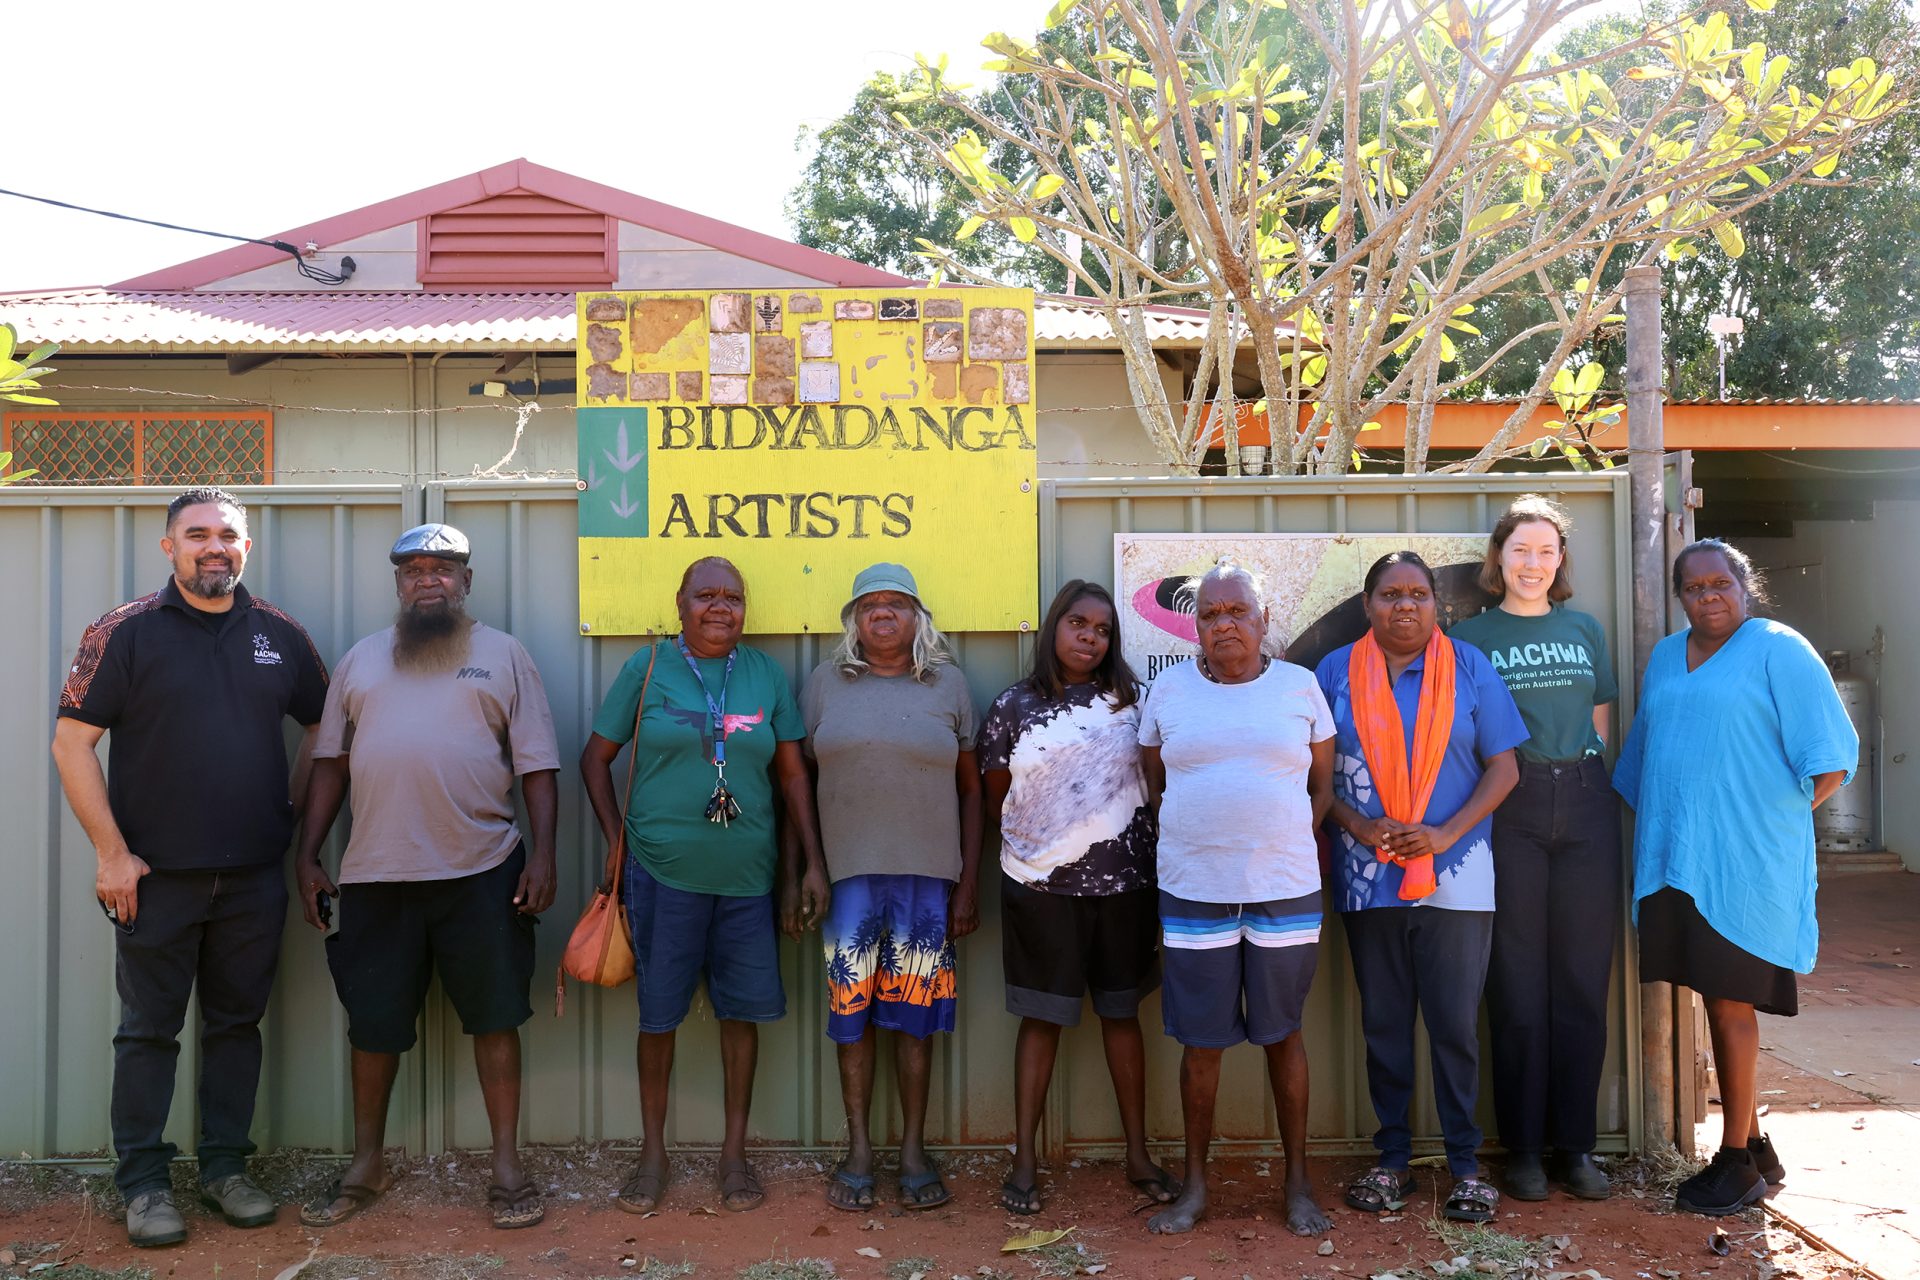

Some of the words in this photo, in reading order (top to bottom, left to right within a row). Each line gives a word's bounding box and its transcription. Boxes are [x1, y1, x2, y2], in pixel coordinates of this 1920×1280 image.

[657, 405, 1036, 451] BIDYADANGA
[658, 492, 914, 539] ARTISTS
[1491, 643, 1592, 669] AACHWA
[1533, 679, 1573, 689] Australia
[1539, 669, 1553, 678] Art
[1554, 667, 1582, 676] Centre
